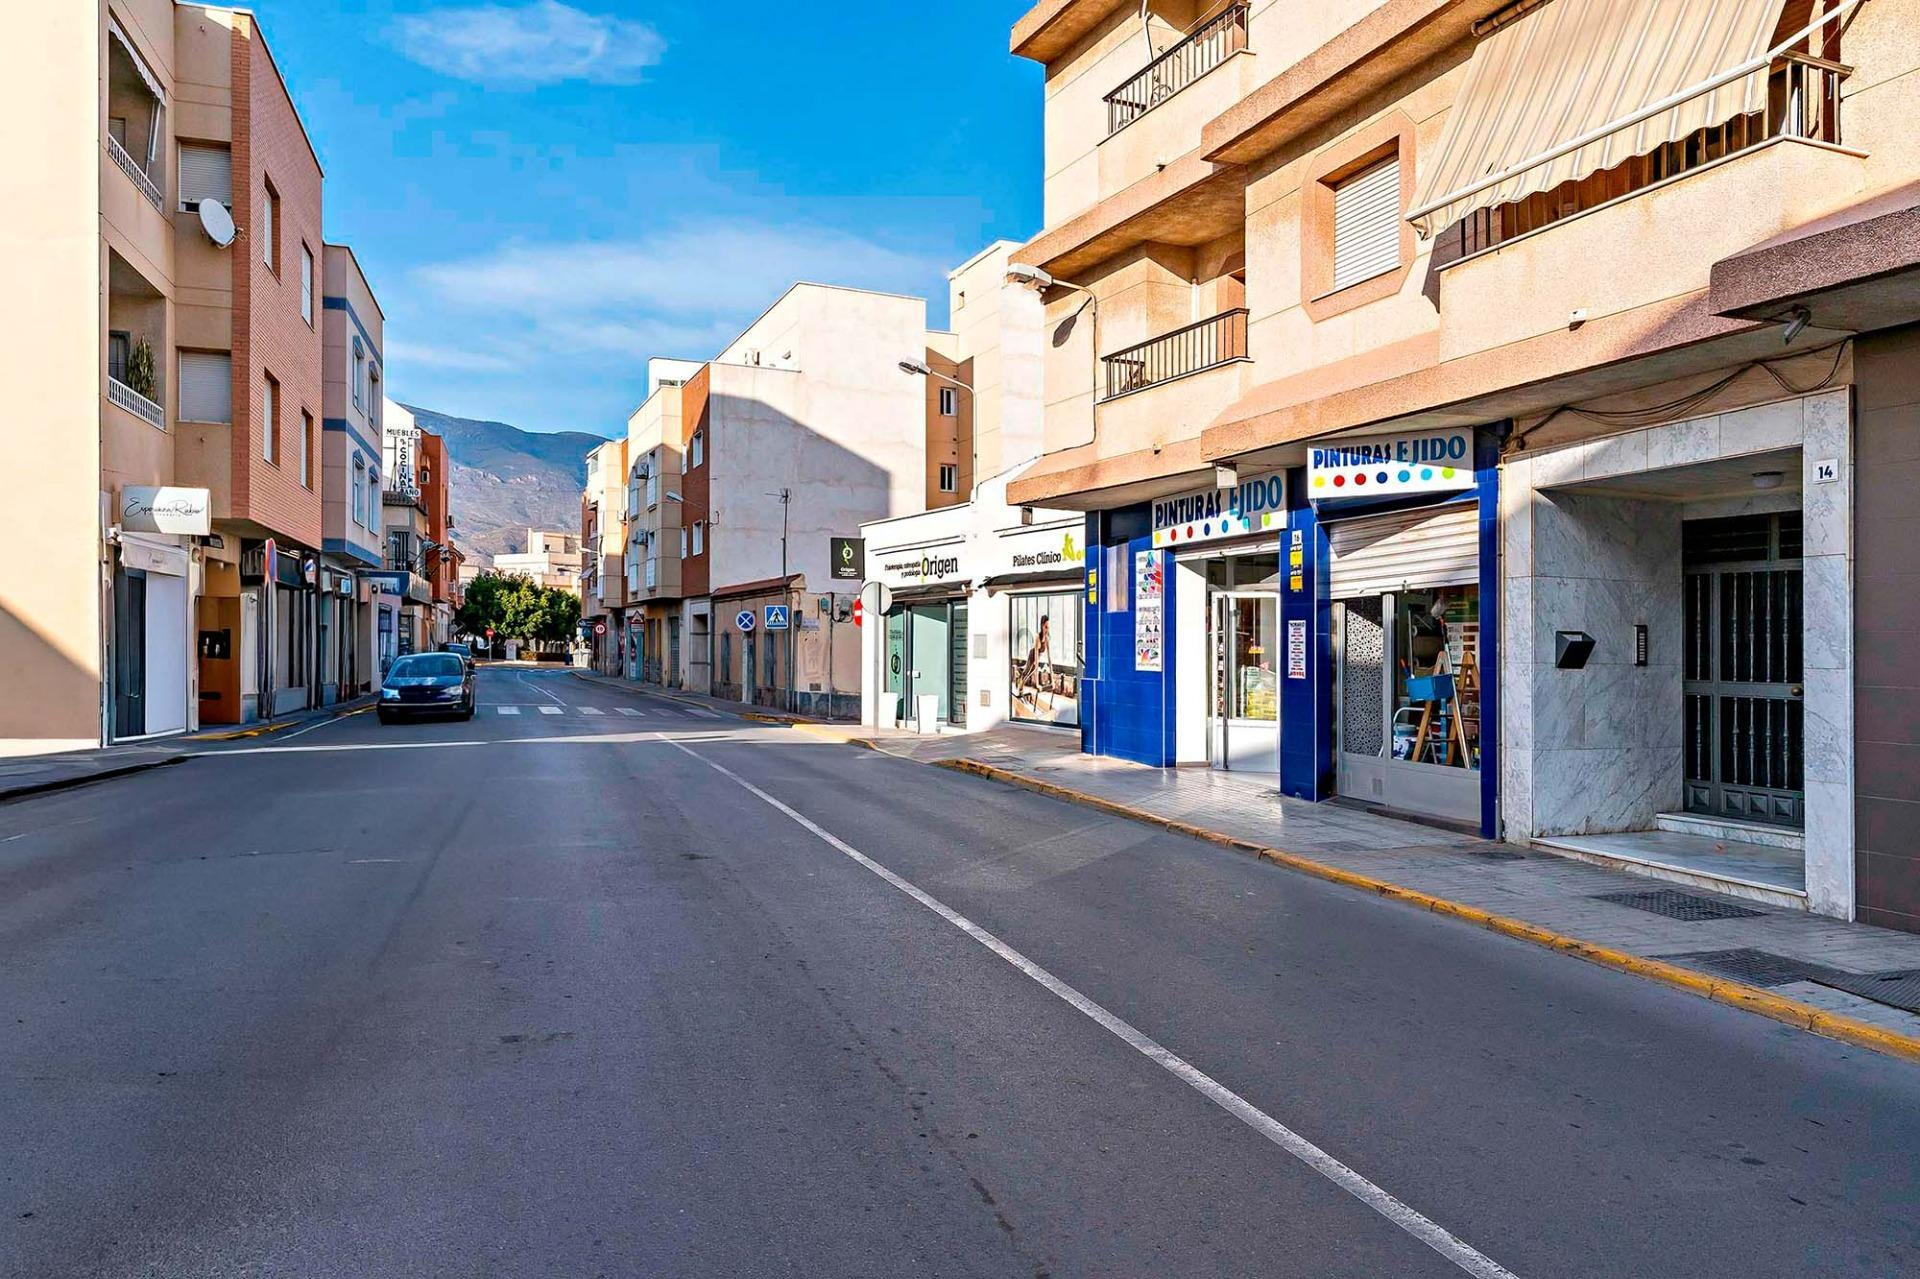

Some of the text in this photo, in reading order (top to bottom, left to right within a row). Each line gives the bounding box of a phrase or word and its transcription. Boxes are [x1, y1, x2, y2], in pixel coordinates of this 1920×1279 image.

[387, 429, 419, 437] MUEBLES
[1313, 435, 1466, 469] PINTURAS EJIDO
[399, 447, 407, 486] COCINA
[1818, 465, 1833, 479] 14
[1155, 475, 1283, 528] PINTURAS EJIDO
[922, 555, 958, 579] Origen
[1013, 554, 1036, 567] Pilates
